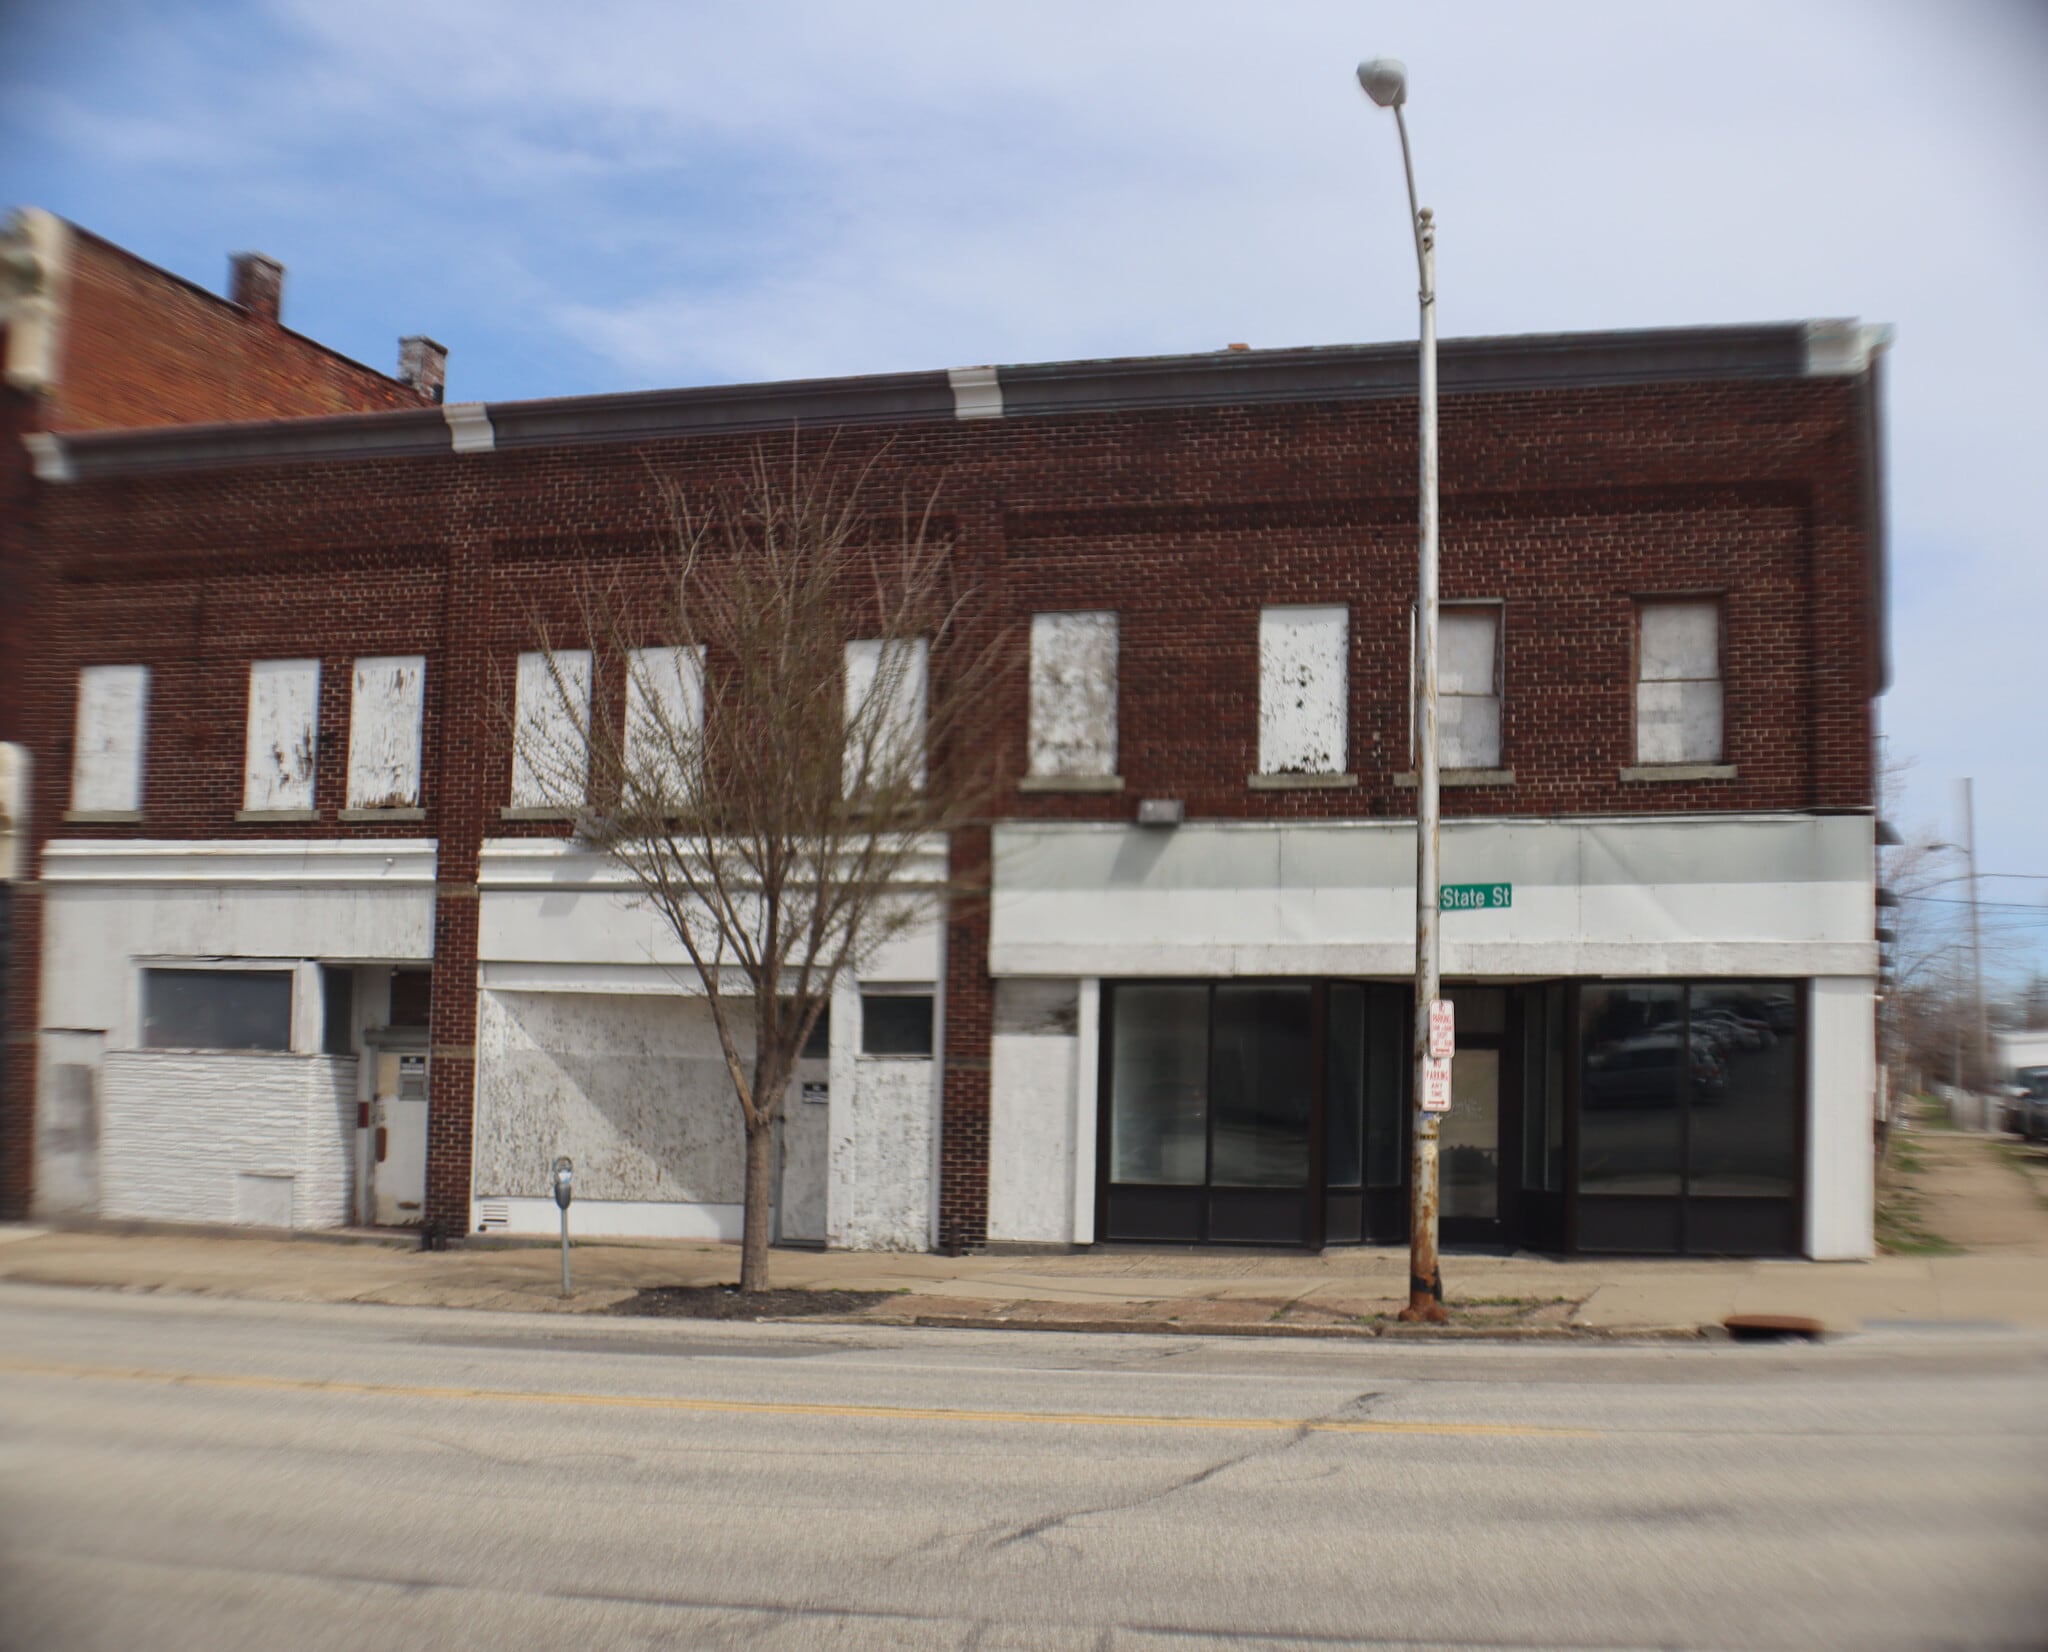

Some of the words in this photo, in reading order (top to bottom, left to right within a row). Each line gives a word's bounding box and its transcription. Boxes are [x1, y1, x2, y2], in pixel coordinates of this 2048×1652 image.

[1443, 887, 1485, 907] State
[1492, 886, 1510, 905] St
[1433, 1058, 1441, 1068] NO
[1426, 1071, 1448, 1080] PARKING
